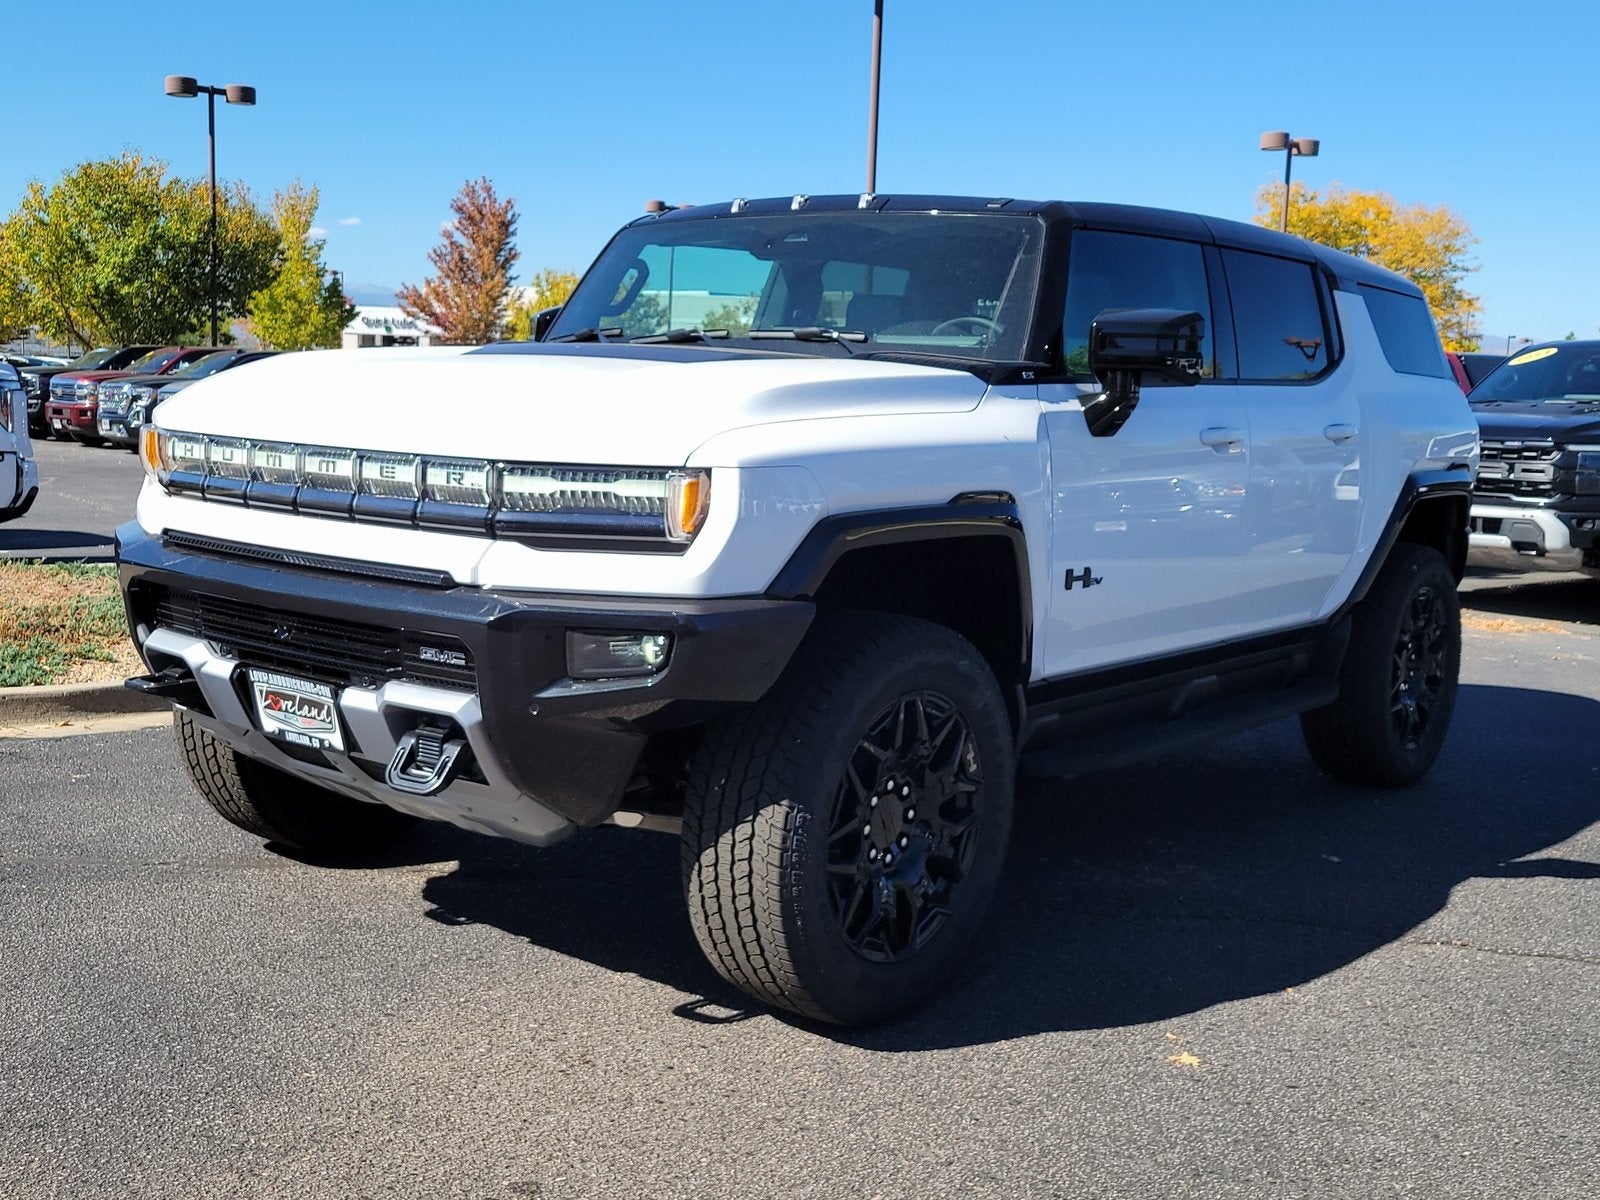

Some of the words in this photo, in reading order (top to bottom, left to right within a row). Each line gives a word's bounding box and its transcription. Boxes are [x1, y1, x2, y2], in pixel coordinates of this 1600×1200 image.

[361, 316, 388, 328] Quick
[183, 443, 464, 486] HUMMER
[420, 646, 466, 666] GMC
